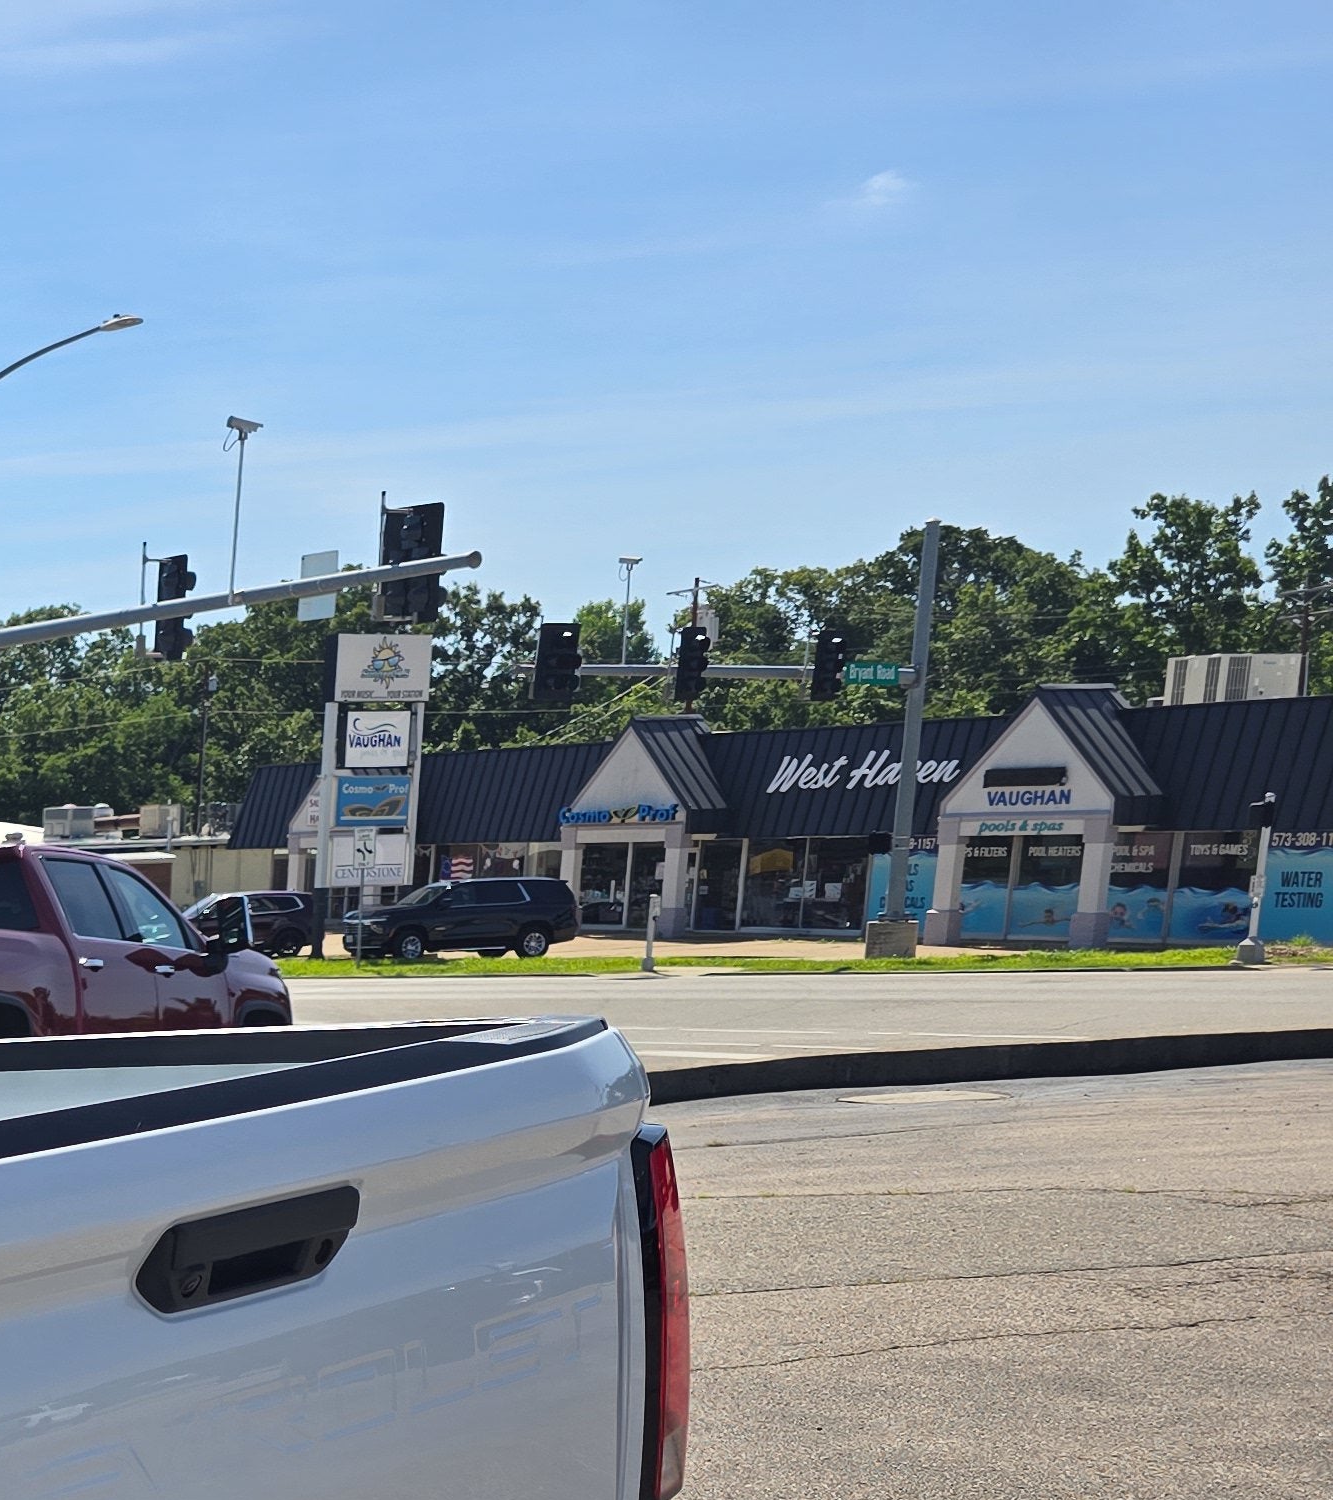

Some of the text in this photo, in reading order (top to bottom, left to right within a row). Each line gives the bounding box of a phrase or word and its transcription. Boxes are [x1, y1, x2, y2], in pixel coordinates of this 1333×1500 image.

[849, 663, 896, 682] Bryant Road
[348, 733, 402, 748] VAUGHAN
[766, 750, 961, 794] West Haen
[342, 783, 374, 794] Cosmo
[987, 789, 1072, 807] VAUGHAN
[559, 804, 679, 825] Cosmo Prof
[978, 820, 1016, 836] pools
[1030, 820, 1065, 835] spas
[334, 866, 403, 879] CENTRSTONE
[1281, 871, 1323, 888] WATER
[1274, 891, 1324, 908] TESTING
